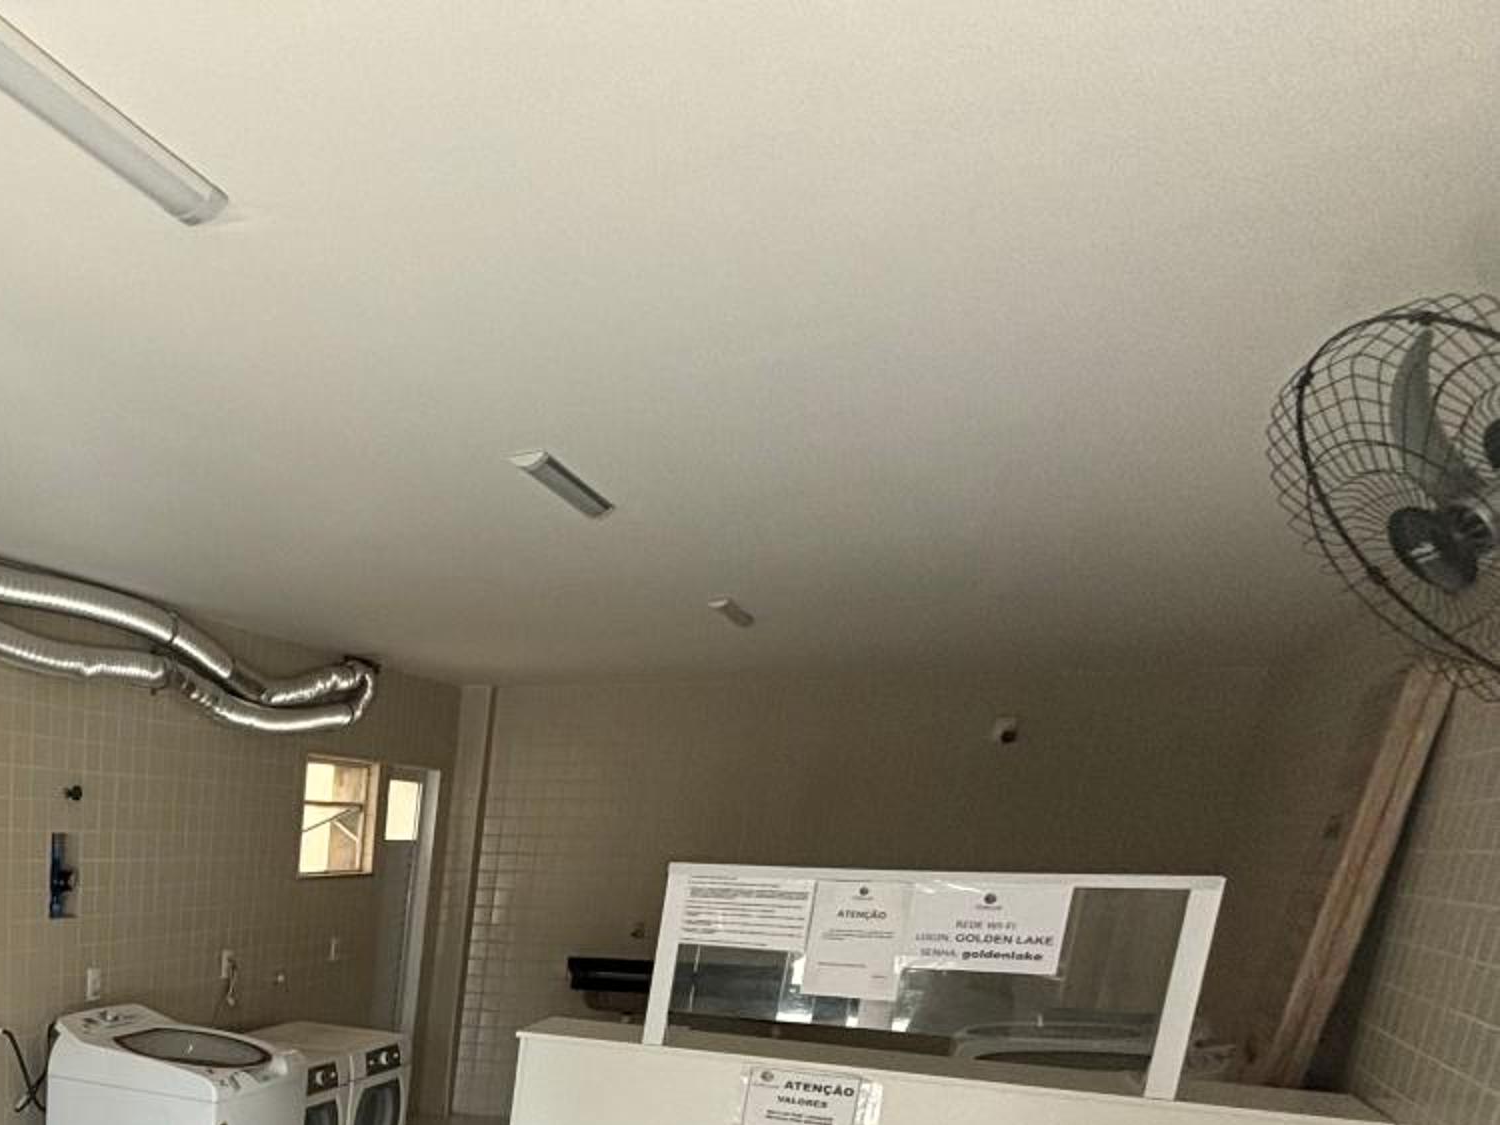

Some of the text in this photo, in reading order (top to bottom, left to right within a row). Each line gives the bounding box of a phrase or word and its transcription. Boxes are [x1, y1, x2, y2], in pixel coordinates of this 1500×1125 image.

[837, 909, 887, 921] ATENÇÃO
[955, 933, 1013, 945] GOLDEN
[1016, 935, 1055, 946] LAKE
[962, 950, 1045, 961] goldenlake
[784, 1081, 855, 1097] ATENÇÃO
[777, 1095, 828, 1109] VALORES
